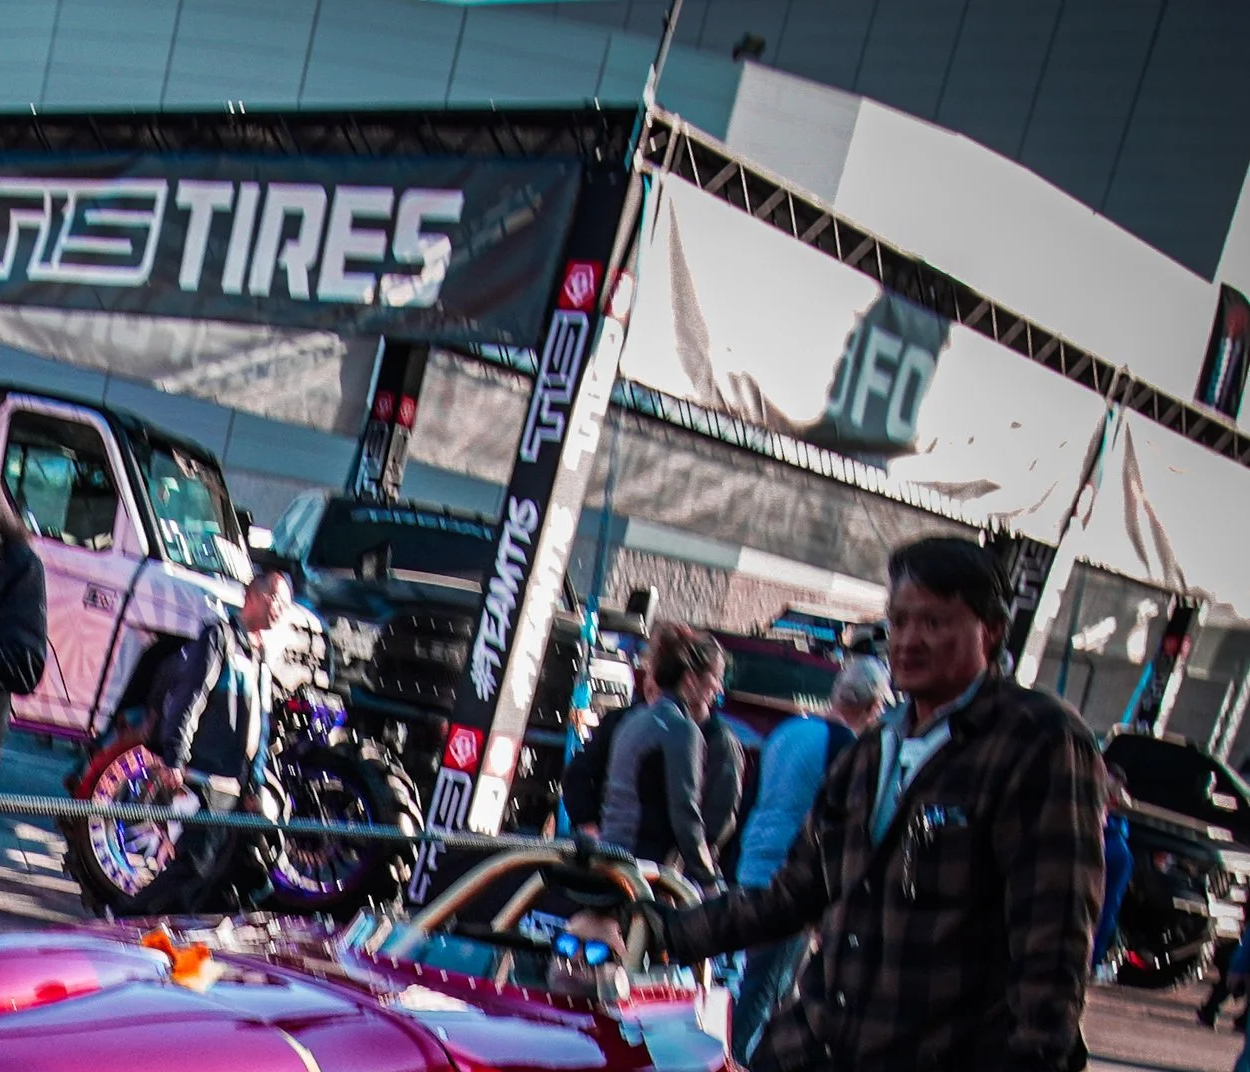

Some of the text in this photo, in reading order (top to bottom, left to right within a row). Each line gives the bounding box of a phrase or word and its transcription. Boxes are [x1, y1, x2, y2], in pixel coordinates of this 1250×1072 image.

[175, 179, 465, 308] TIRES
[519, 308, 590, 464] TIS
[469, 495, 539, 702] #TEAMTIS
